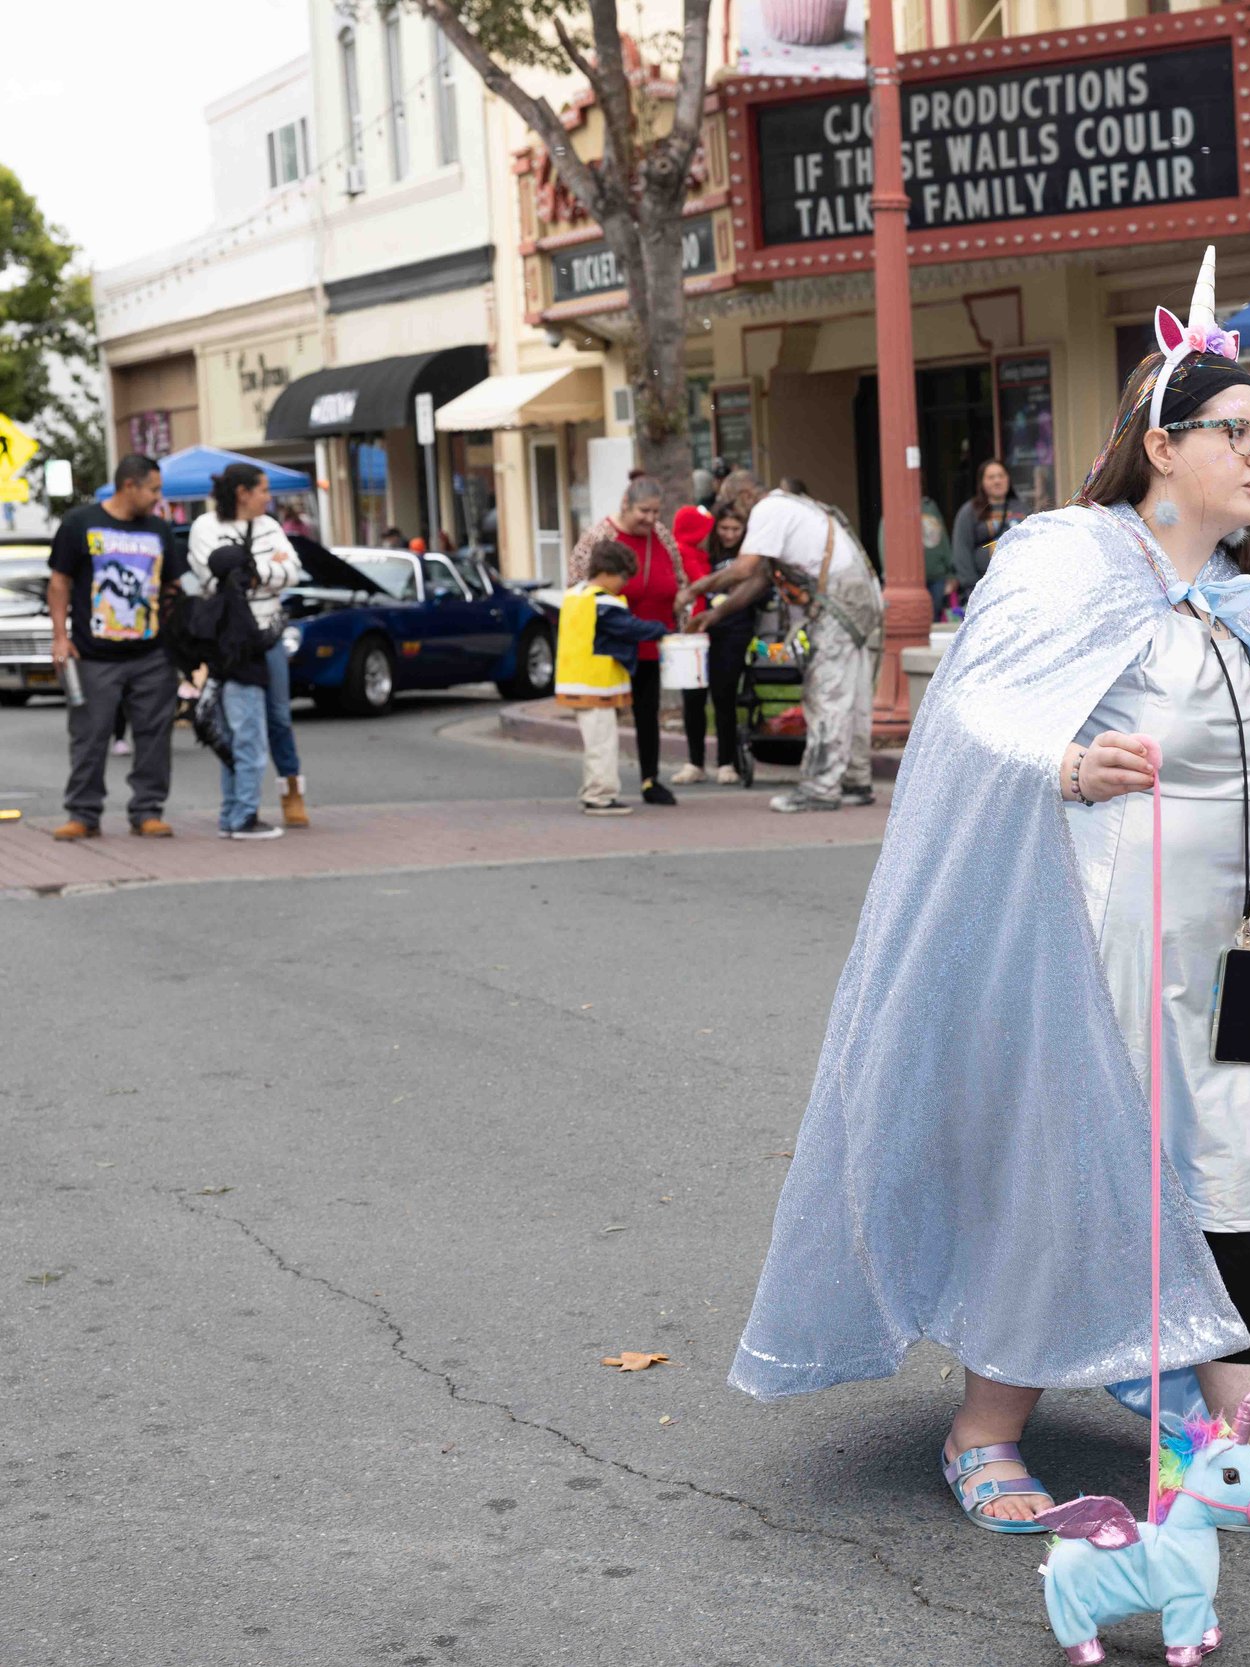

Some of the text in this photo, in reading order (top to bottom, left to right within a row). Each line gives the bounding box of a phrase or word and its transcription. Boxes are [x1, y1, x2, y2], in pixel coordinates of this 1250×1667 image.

[910, 63, 1149, 133] PRODUCTIONS
[794, 107, 1194, 193] IF THSE WALLS COULD
[923, 172, 1047, 223] FAMILY
[1066, 155, 1195, 209] AFFAIR
